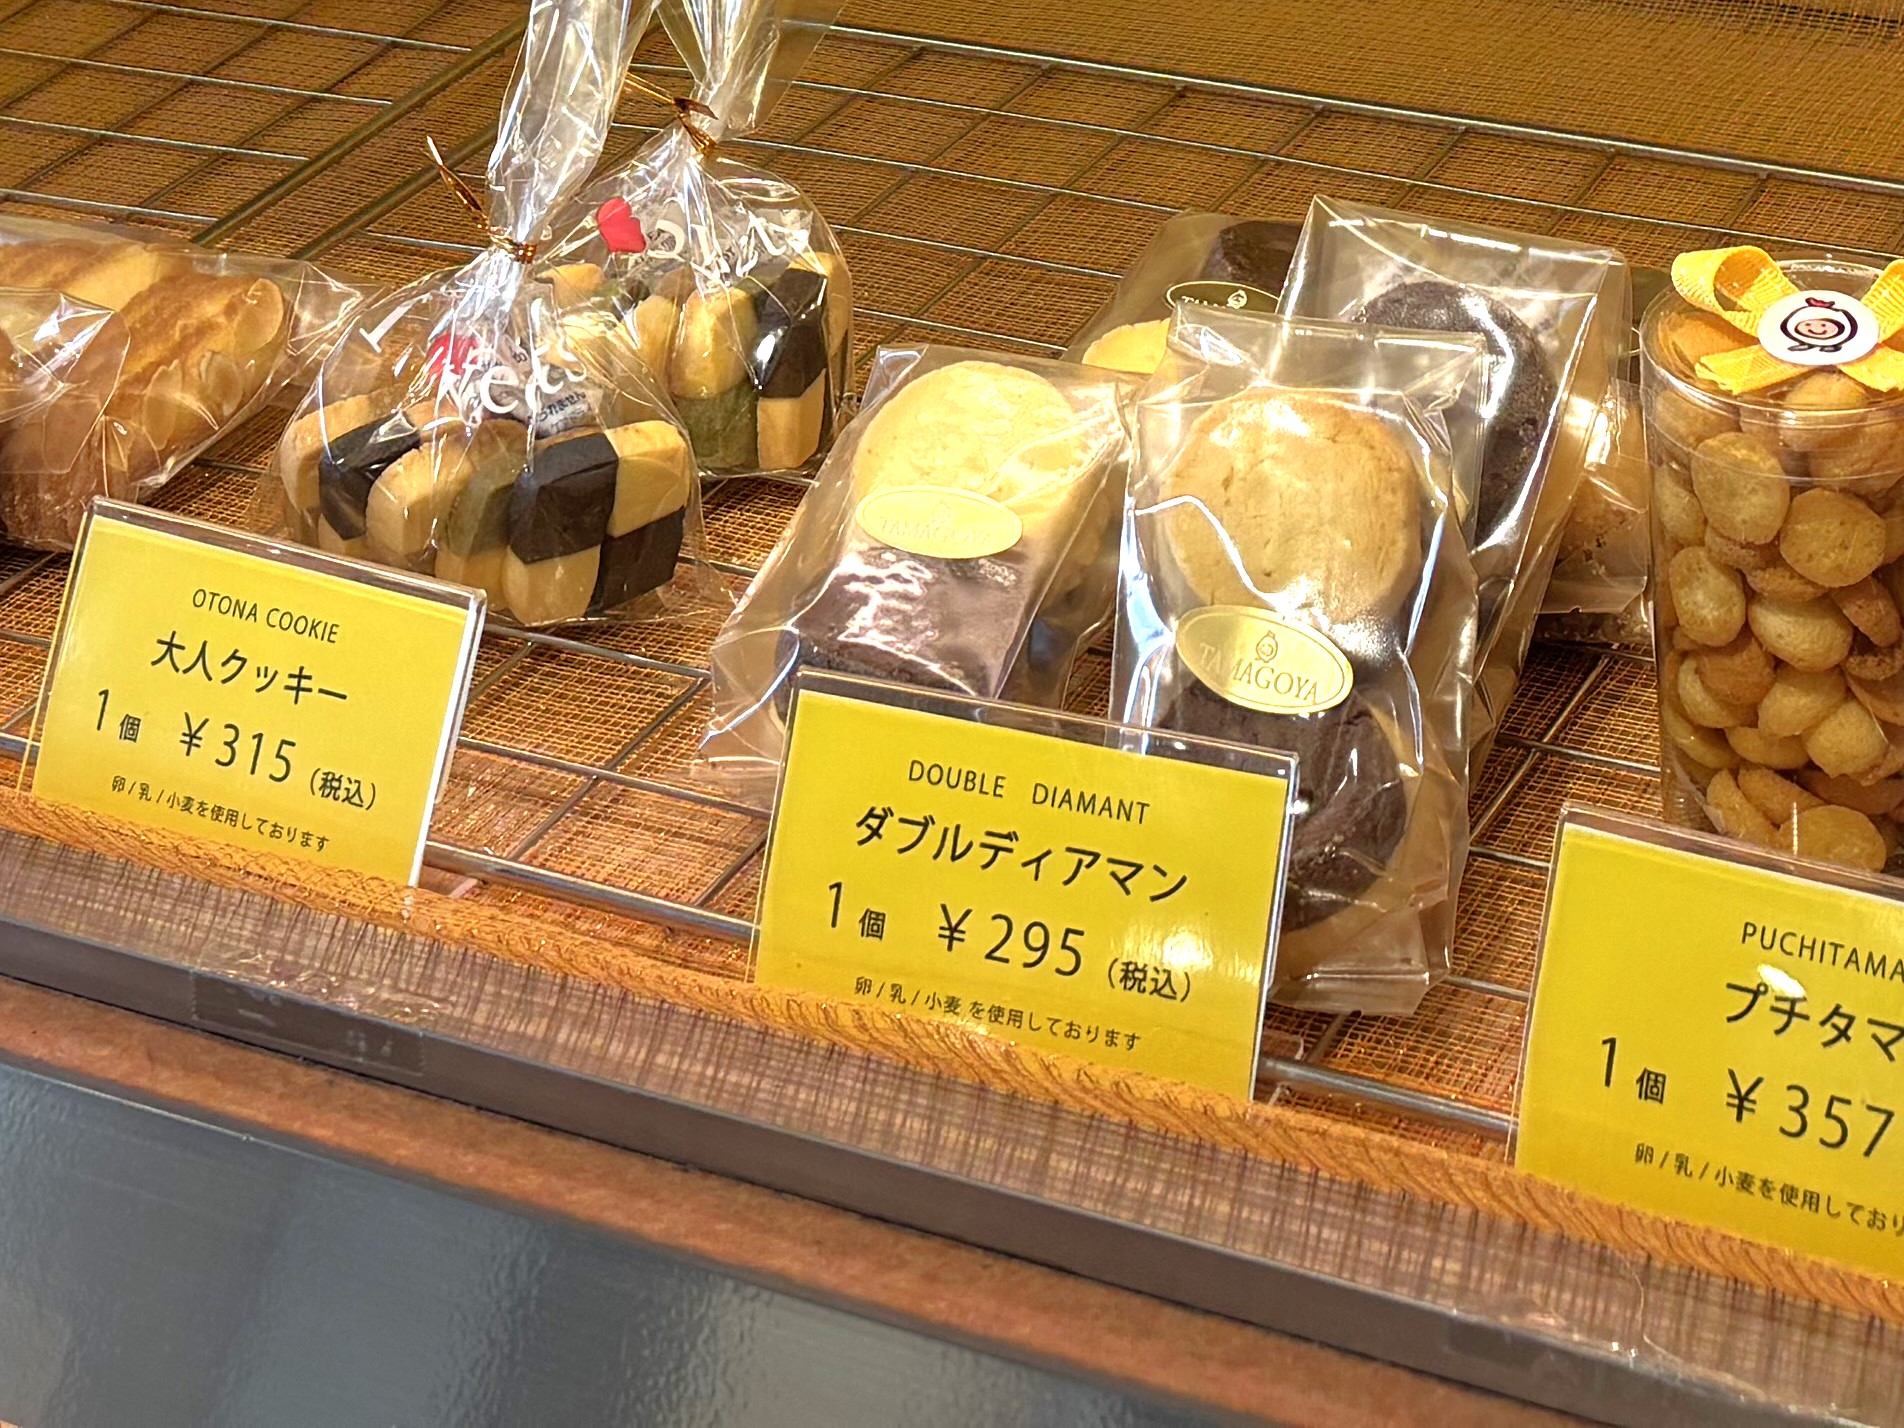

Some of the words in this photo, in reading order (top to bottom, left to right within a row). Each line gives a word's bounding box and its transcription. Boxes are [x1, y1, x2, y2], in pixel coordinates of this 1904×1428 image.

[191, 587, 259, 623] OTONA
[266, 607, 340, 644] COOKIE
[150, 630, 348, 705] 大人クッキー
[1199, 642, 1319, 705] TAMAGOYA
[907, 758, 1007, 799] DOUBLE
[1031, 782, 1151, 826] DIAMANT
[855, 805, 1189, 903] ダブルディアマン
